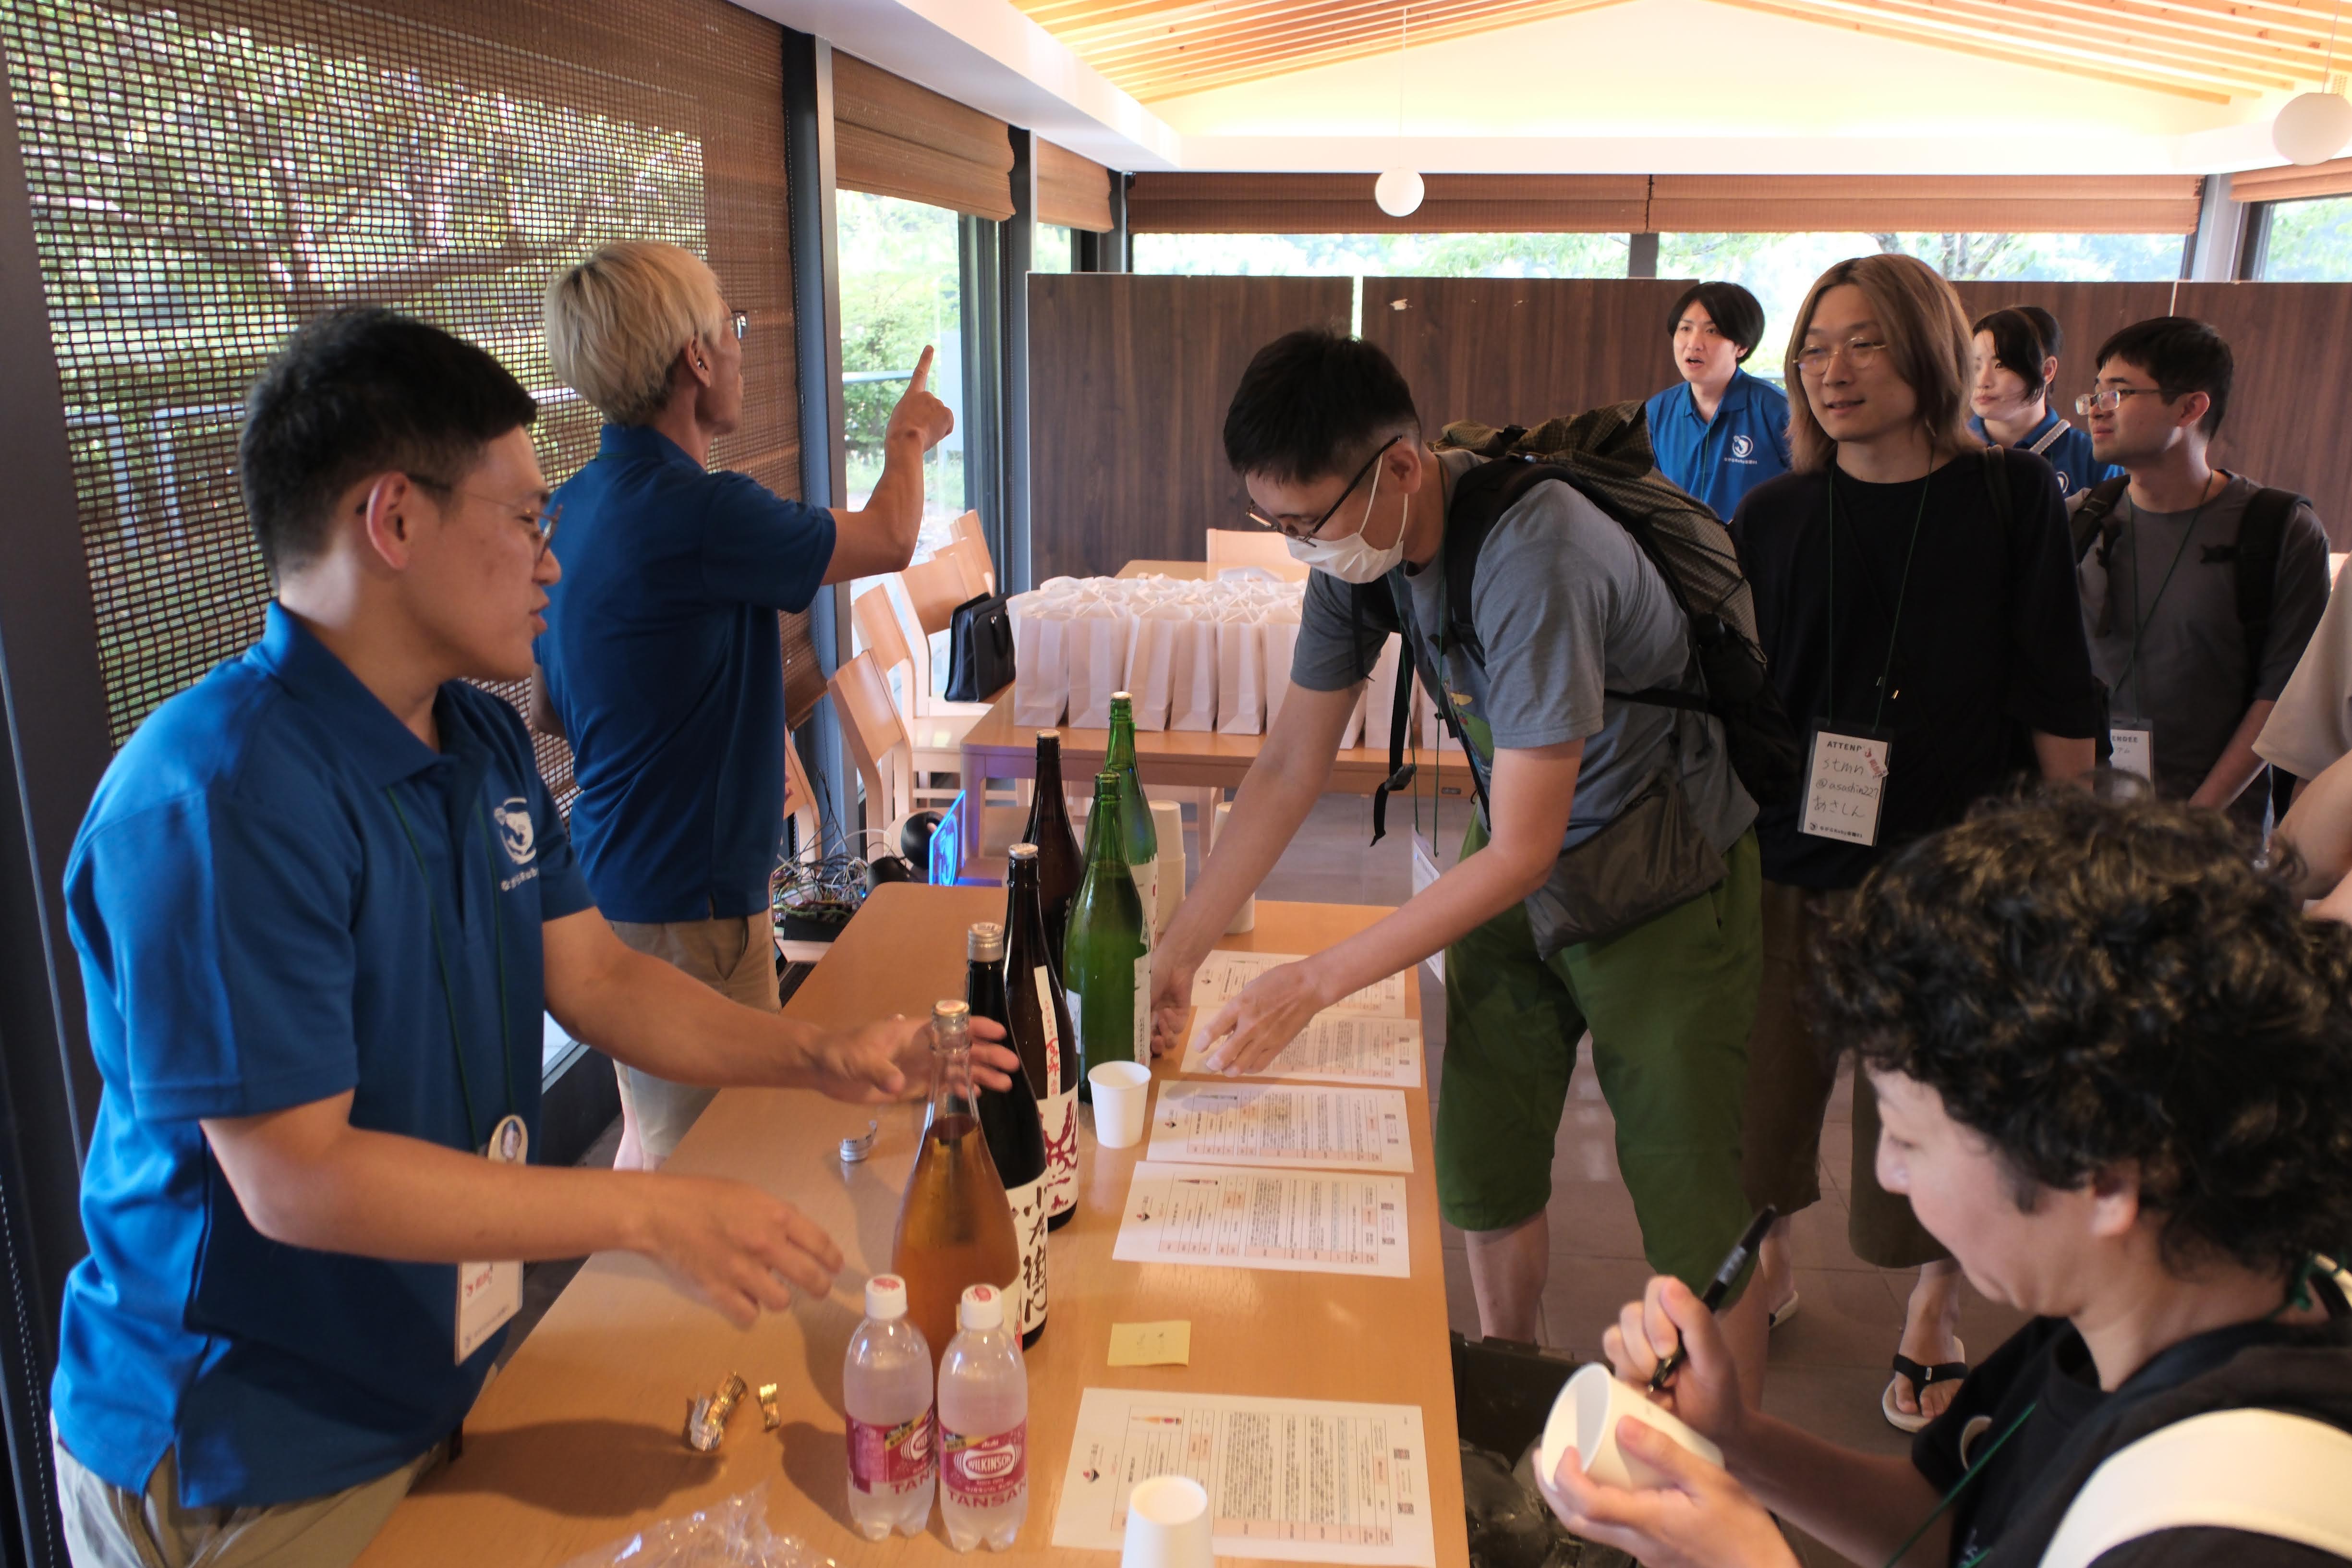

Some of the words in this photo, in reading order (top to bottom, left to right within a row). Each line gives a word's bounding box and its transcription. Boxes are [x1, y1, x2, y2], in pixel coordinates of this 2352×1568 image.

[1827, 741, 1862, 752] ATTEND
[1813, 795, 1865, 818] あさしん
[968, 1454, 1011, 1473] WILKINSON
